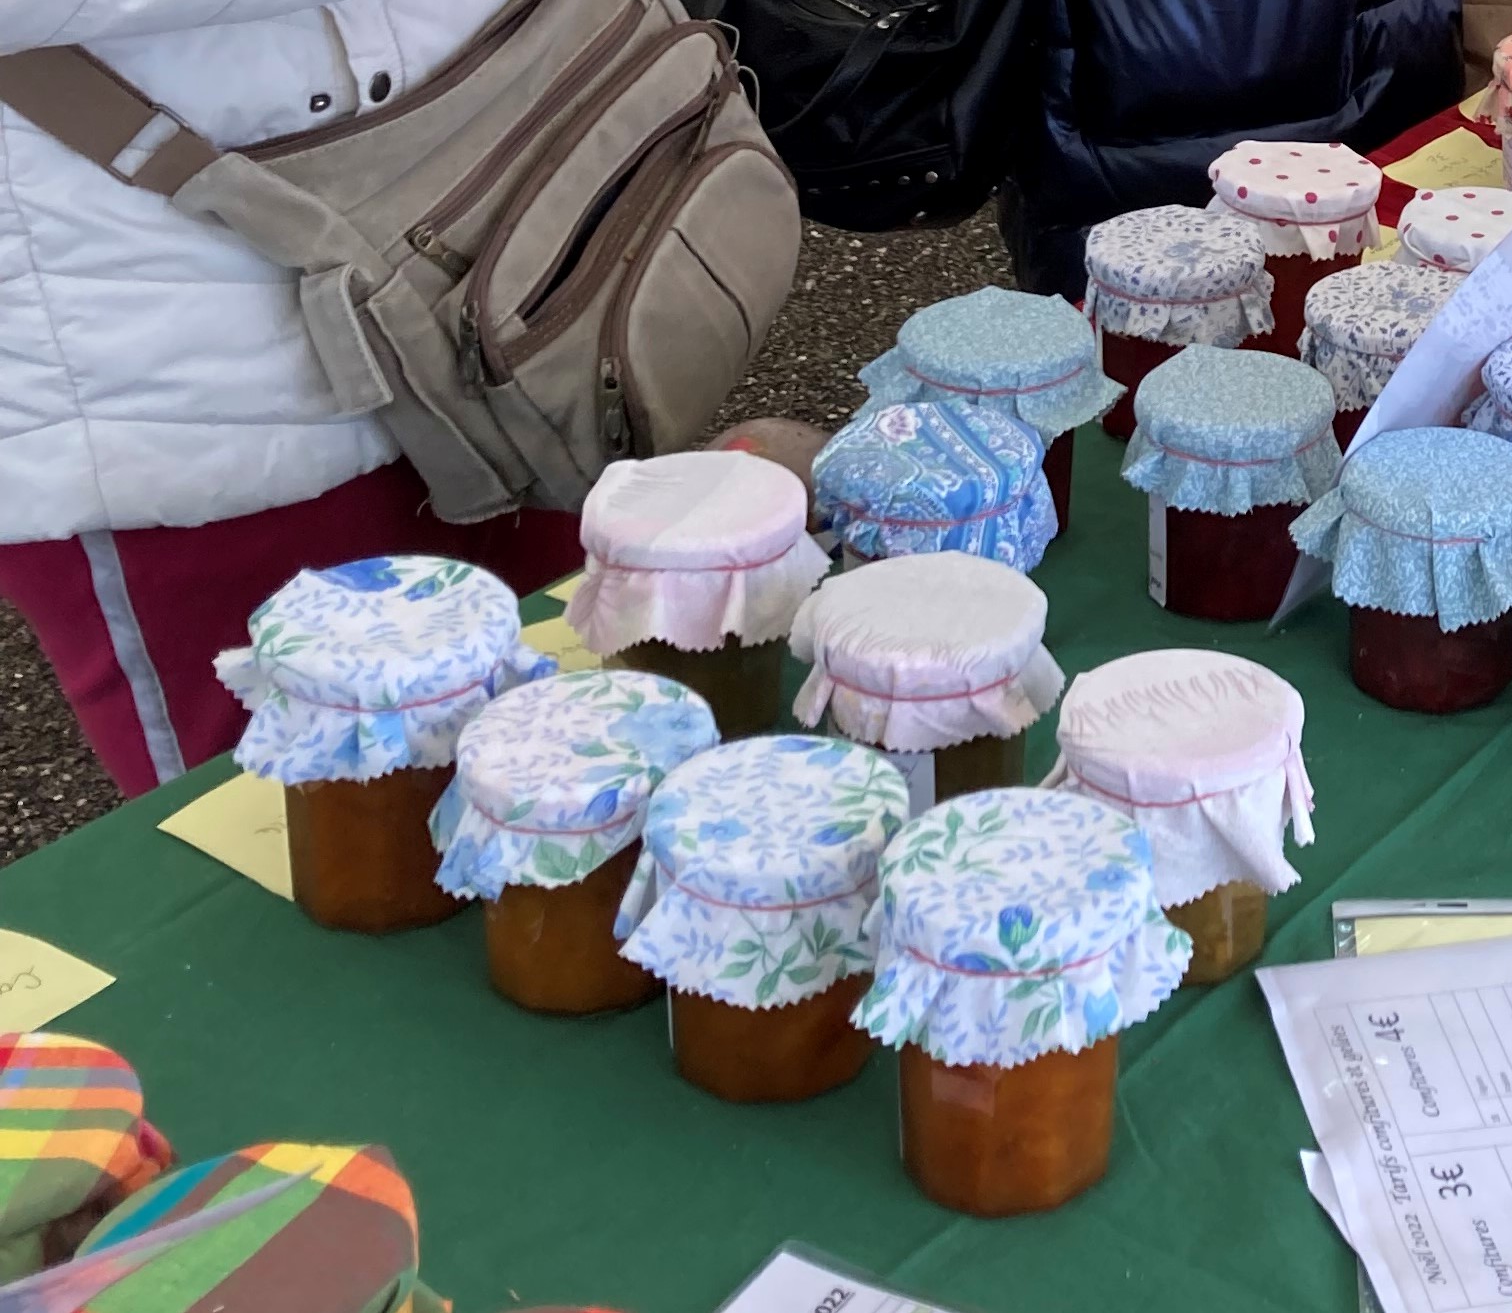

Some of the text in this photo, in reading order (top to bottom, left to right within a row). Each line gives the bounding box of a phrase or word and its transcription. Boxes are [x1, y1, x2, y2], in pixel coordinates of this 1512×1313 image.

[1345, 1064, 1364, 1079] et
[1368, 1012, 1440, 1118] Confitures 4€
[1354, 1080, 1393, 1151] confitures
[1378, 1155, 1411, 1205] Tarifs
[1430, 1163, 1473, 1200] 3€
[1404, 1213, 1429, 1248] 2022
[1412, 1250, 1447, 1285] Noël
